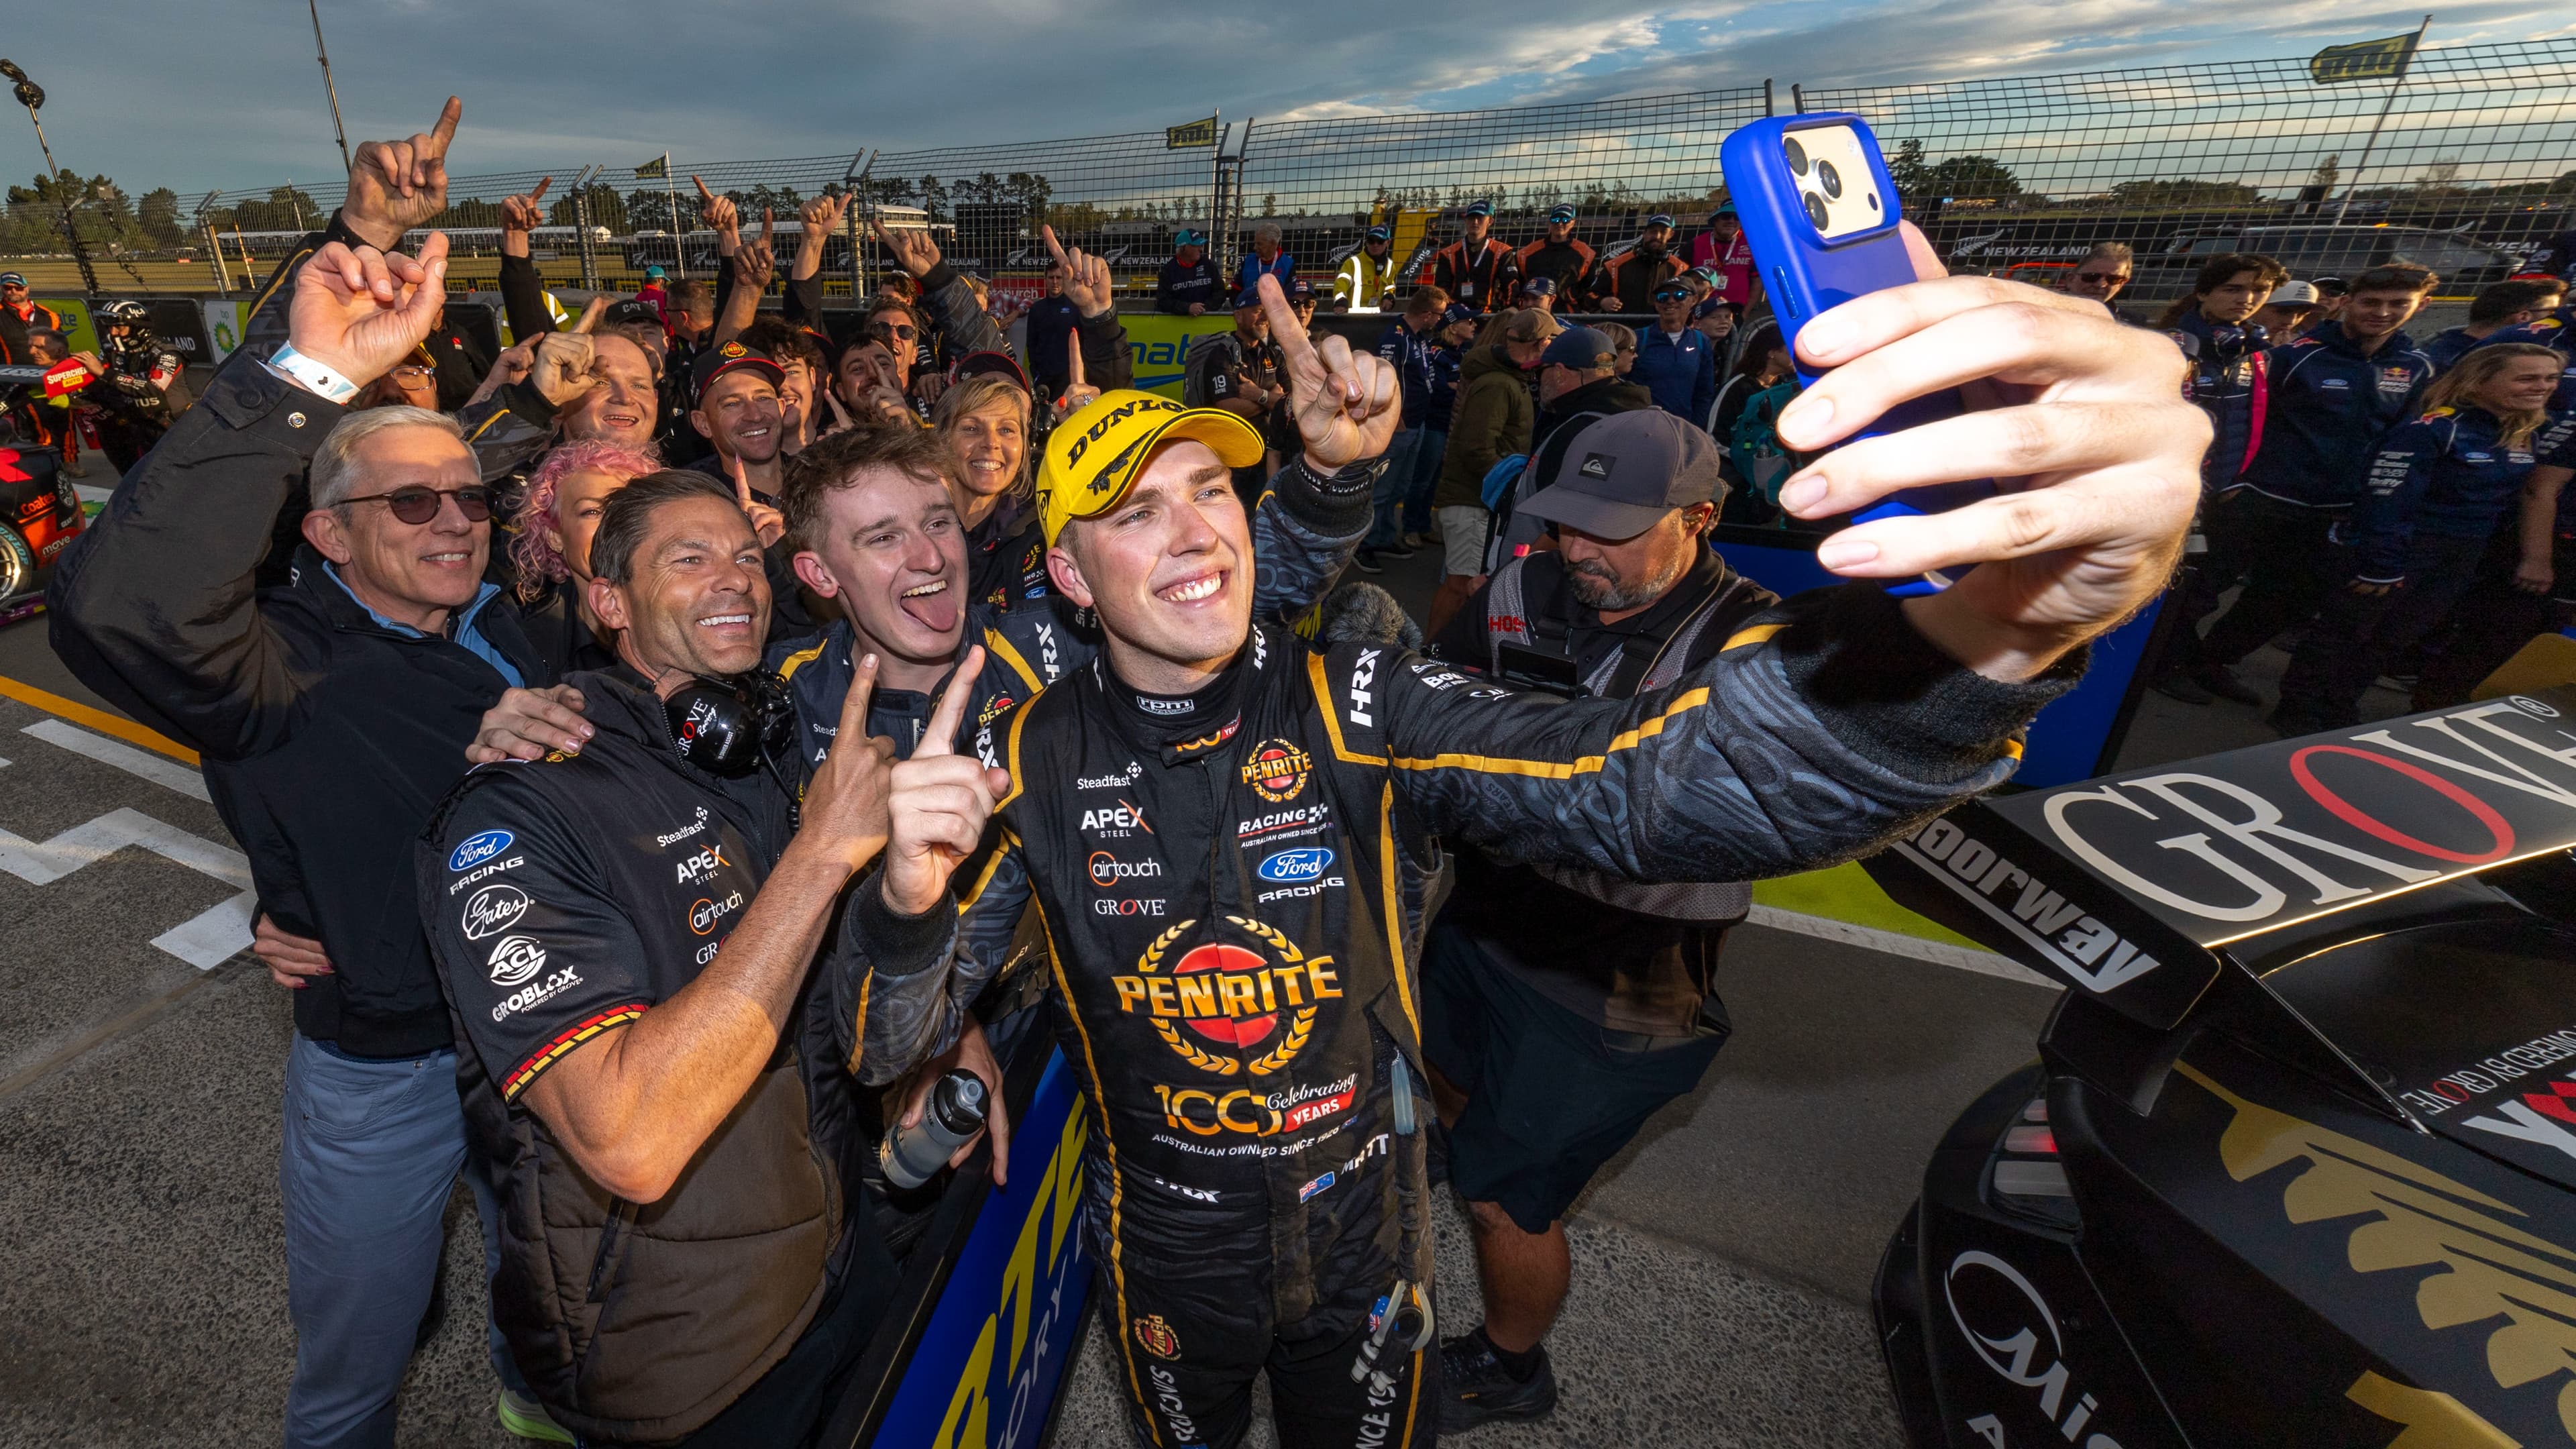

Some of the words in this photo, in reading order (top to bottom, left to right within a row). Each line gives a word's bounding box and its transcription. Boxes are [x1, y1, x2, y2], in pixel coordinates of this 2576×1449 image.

[1122, 257, 1140, 265] NEW
[1984, 246, 2020, 256] NEW
[2021, 246, 2091, 256] ZEALAND
[1212, 374, 1226, 389] 19
[1067, 398, 1189, 470] DUNLO
[20, 492, 56, 516] Coates
[43, 535, 70, 556] move
[1489, 616, 1526, 633] HOS
[1035, 622, 1060, 685] HRX
[1428, 659, 1450, 667] SONY
[1350, 647, 1382, 728] HRX
[1141, 698, 1189, 710] rpm
[813, 724, 839, 736] Stead
[975, 721, 1000, 771] HRX
[1242, 751, 1313, 785] PENRITE
[1077, 774, 1132, 790] Steadfast
[1081, 800, 1152, 833] APEX
[1239, 809, 1306, 834] RACING
[657, 820, 706, 847] Steadfast
[1100, 829, 1131, 838] STEEL
[1241, 835, 1277, 849] AUSTRALIAN
[1277, 831, 1300, 840] OWNED
[1300, 828, 1318, 836] SINCE
[458, 837, 498, 867] Ford
[678, 845, 730, 883] APEX
[1275, 853, 1321, 877] Ford
[449, 856, 524, 896] RACING
[695, 869, 718, 885] STEEL
[1093, 857, 1161, 877] airtouch
[1258, 877, 1345, 904] RACING
[468, 893, 523, 930] Gates
[693, 890, 743, 928] airtouch
[1095, 899, 1165, 916] GROVE
[490, 944, 545, 978] ACL
[492, 965, 578, 1022] GROBLOX
[521, 995, 549, 1014] POWERED
[548, 990, 557, 999] BY
[557, 979, 581, 994] GROVE
[1111, 955, 1344, 1019] PENRITE
[1267, 1072, 1358, 1111] Celebrating
[1152, 1084, 1283, 1138] 100
[1292, 1098, 1340, 1126] YEARS
[1152, 1134, 1226, 1157] AUSTRALIAN
[1280, 1138, 1315, 1156] SINCE
[1341, 1134, 1389, 1175] MATT
